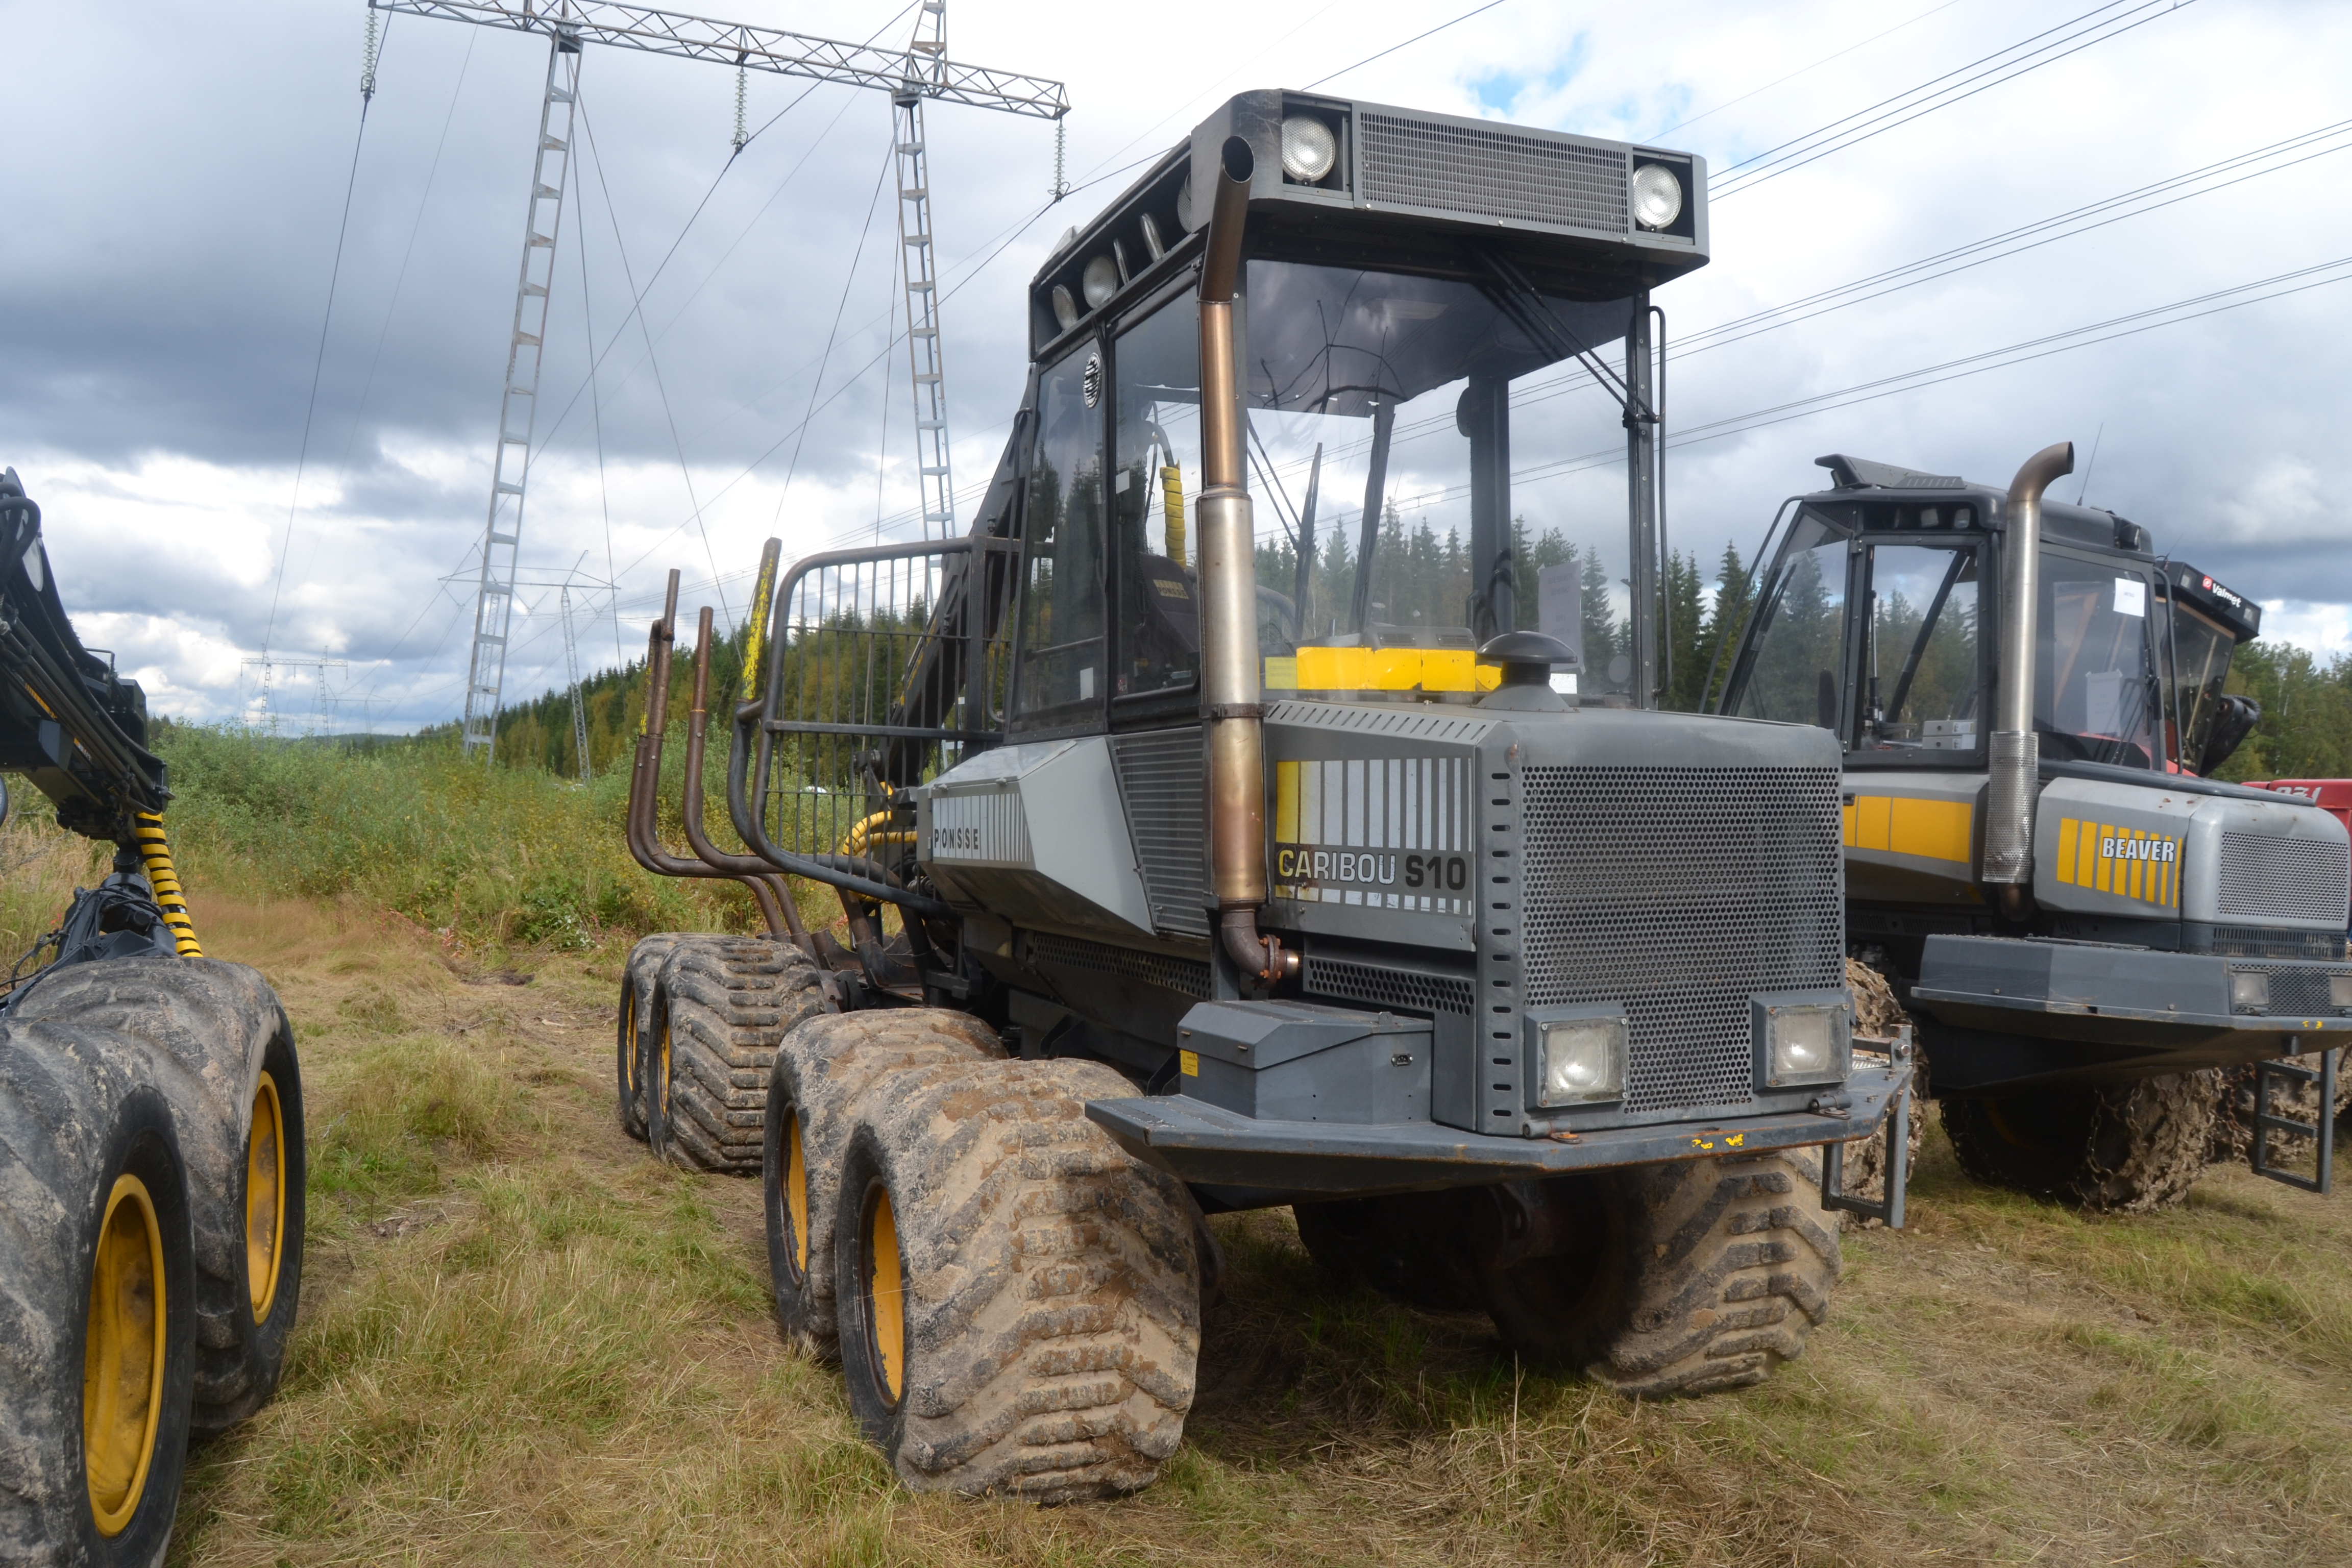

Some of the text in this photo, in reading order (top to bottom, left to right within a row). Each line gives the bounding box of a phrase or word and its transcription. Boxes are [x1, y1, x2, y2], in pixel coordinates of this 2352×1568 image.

[2212, 583, 2241, 608] Valmet
[935, 828, 978, 850] PONSSE
[2102, 837, 2175, 862] BEAVER
[1278, 849, 1466, 890] CARIBOU S10
